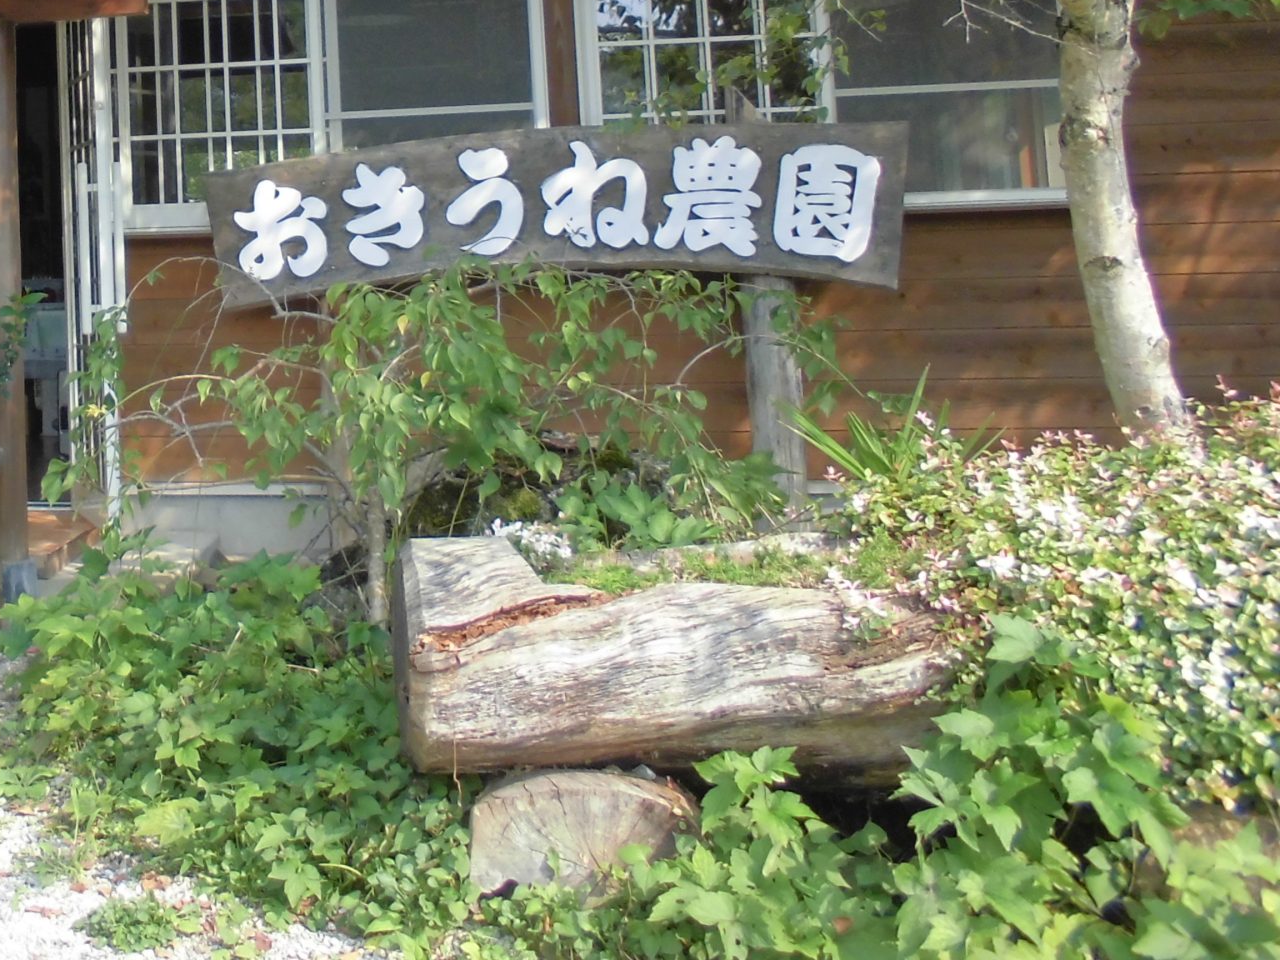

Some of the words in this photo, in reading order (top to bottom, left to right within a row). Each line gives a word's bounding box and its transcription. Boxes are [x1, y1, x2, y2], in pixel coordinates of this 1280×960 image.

[233, 135, 882, 281] おきうね農園
